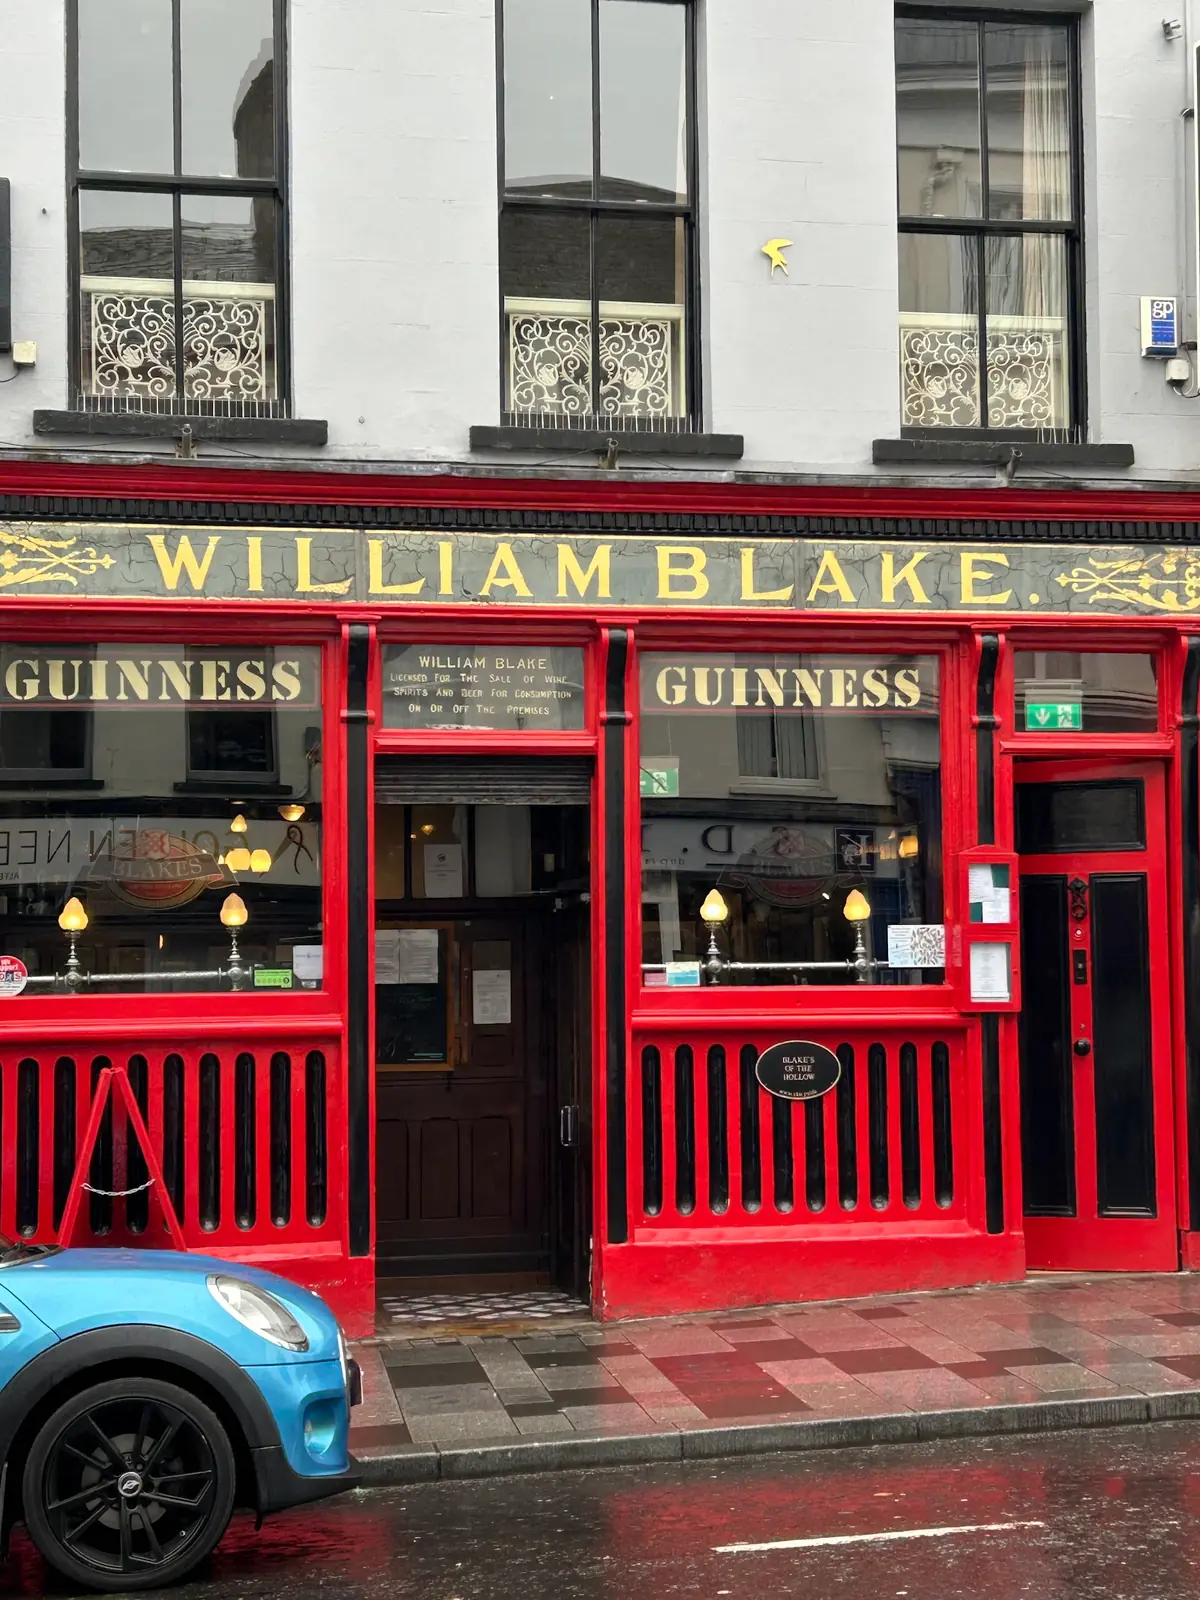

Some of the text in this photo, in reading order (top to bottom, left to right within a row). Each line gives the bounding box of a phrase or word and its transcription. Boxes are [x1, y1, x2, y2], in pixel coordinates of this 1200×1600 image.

[1152, 301, 1173, 319] gp
[146, 534, 1040, 605] WILLIAM BLAKE.
[419, 656, 547, 670] WILLIAM BLAKE
[5, 659, 302, 701] GUINNESS
[655, 665, 922, 708] GUINNESS
[112, 858, 202, 878] BLAKES
[783, 1073, 816, 1081] HOLLOW
